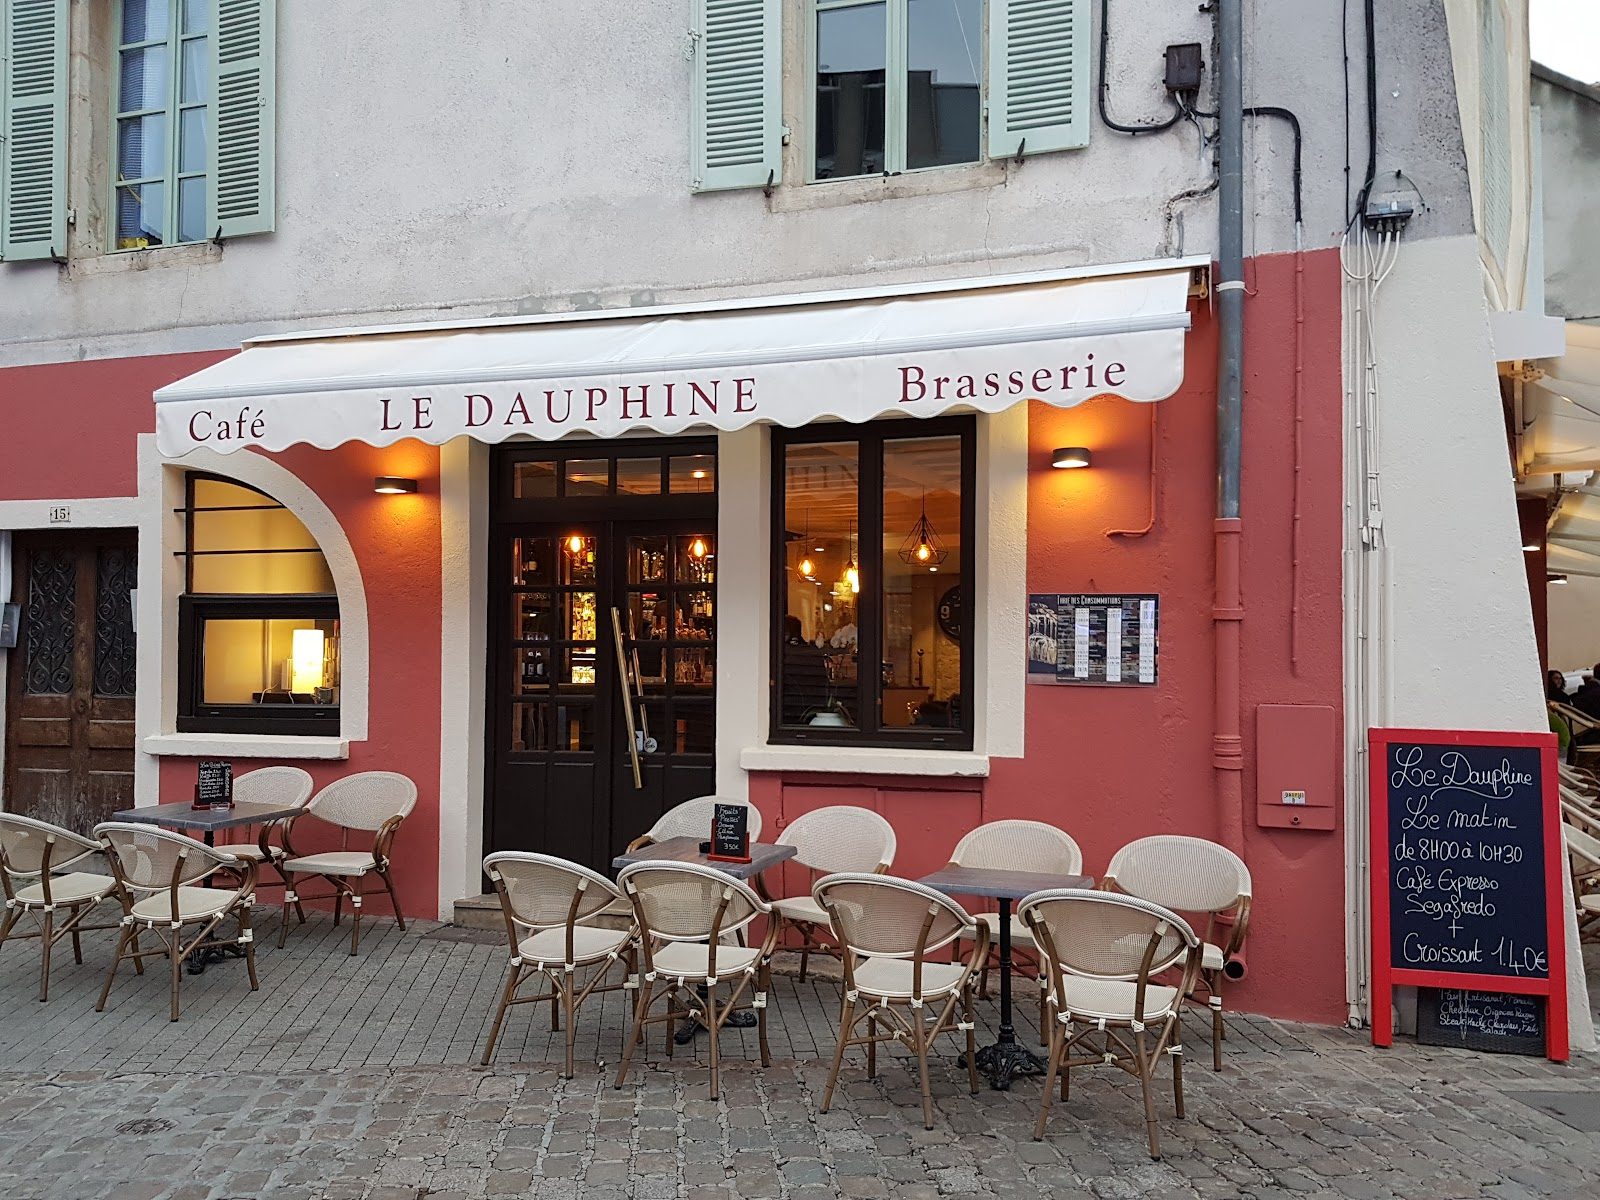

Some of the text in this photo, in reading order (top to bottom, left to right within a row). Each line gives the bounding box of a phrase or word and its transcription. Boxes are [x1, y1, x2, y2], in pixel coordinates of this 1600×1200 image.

[188, 352, 1127, 442] Café LE DAUPHINE Brasserie
[53, 508, 66, 520] 15
[1391, 746, 1533, 796] Le Dauphine
[1401, 795, 1518, 830] Le matin
[1395, 832, 1523, 864] de 8H00 à 10H30
[1396, 865, 1499, 899] Café Expresso
[1404, 892, 1496, 921] Segafredo
[1447, 918, 1464, 939] +
[1403, 932, 1549, 975] Croissant 1.40€
